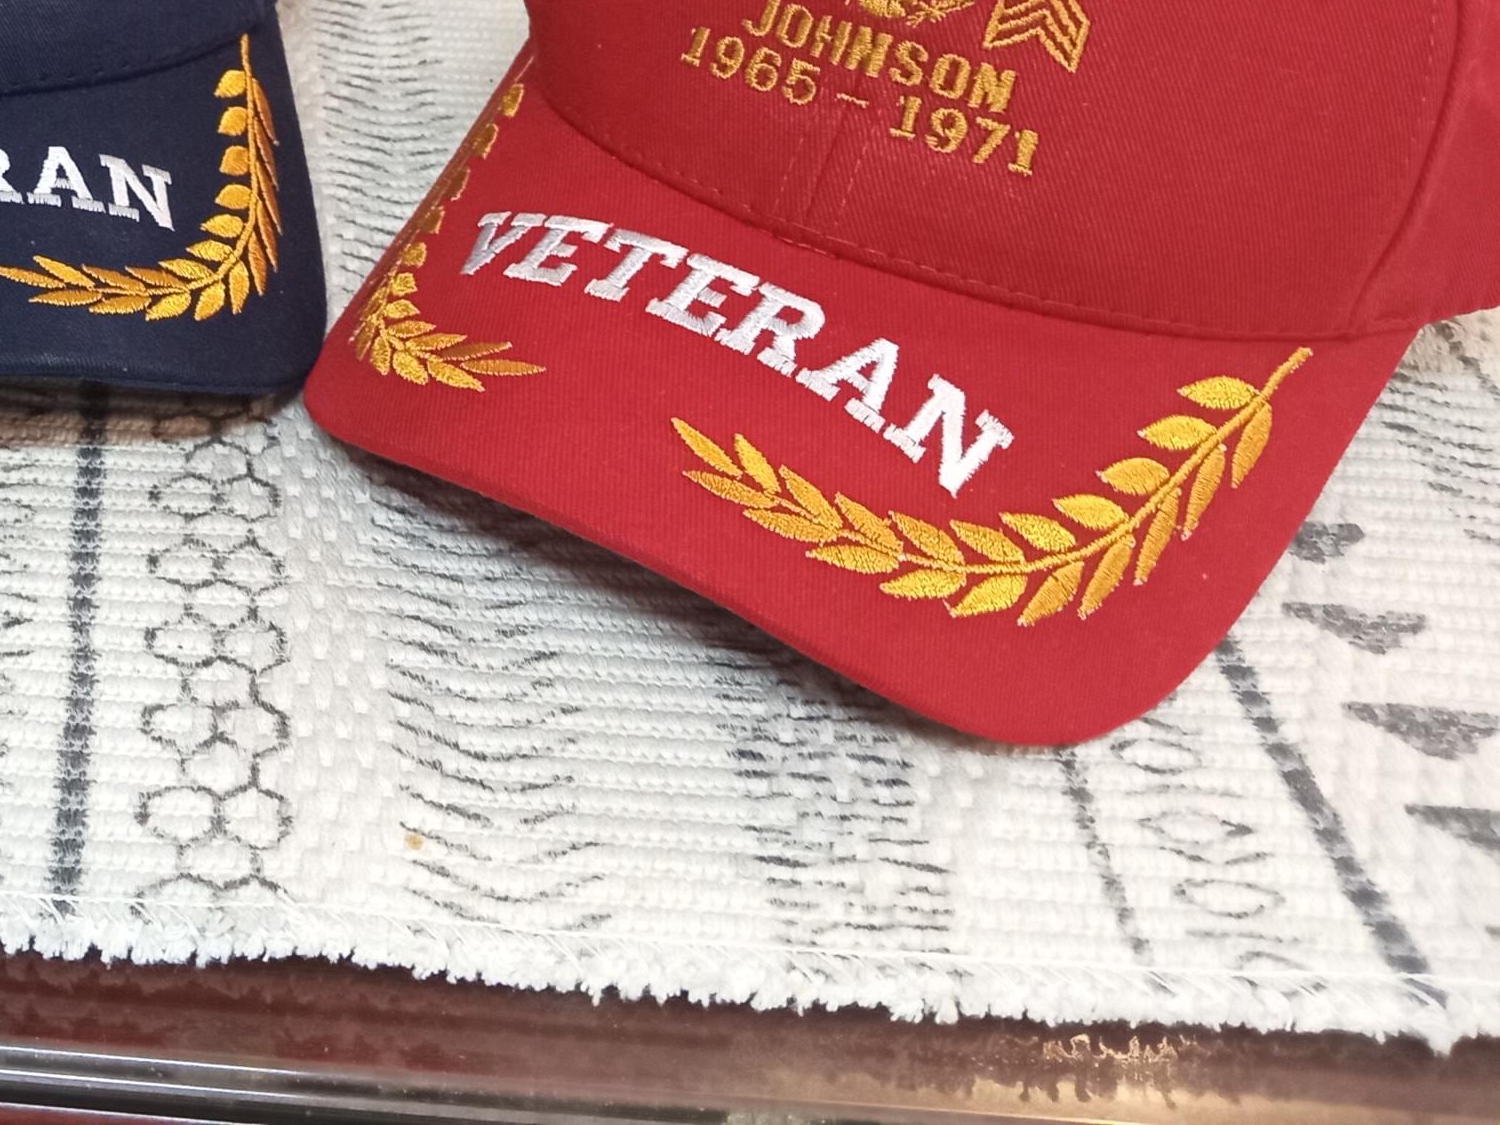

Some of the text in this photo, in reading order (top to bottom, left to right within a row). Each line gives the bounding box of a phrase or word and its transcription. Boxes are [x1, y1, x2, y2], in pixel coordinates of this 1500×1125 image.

[680, 26, 821, 106] 1965
[889, 95, 1040, 177] 1971
[460, 211, 1014, 498] VETERAN
